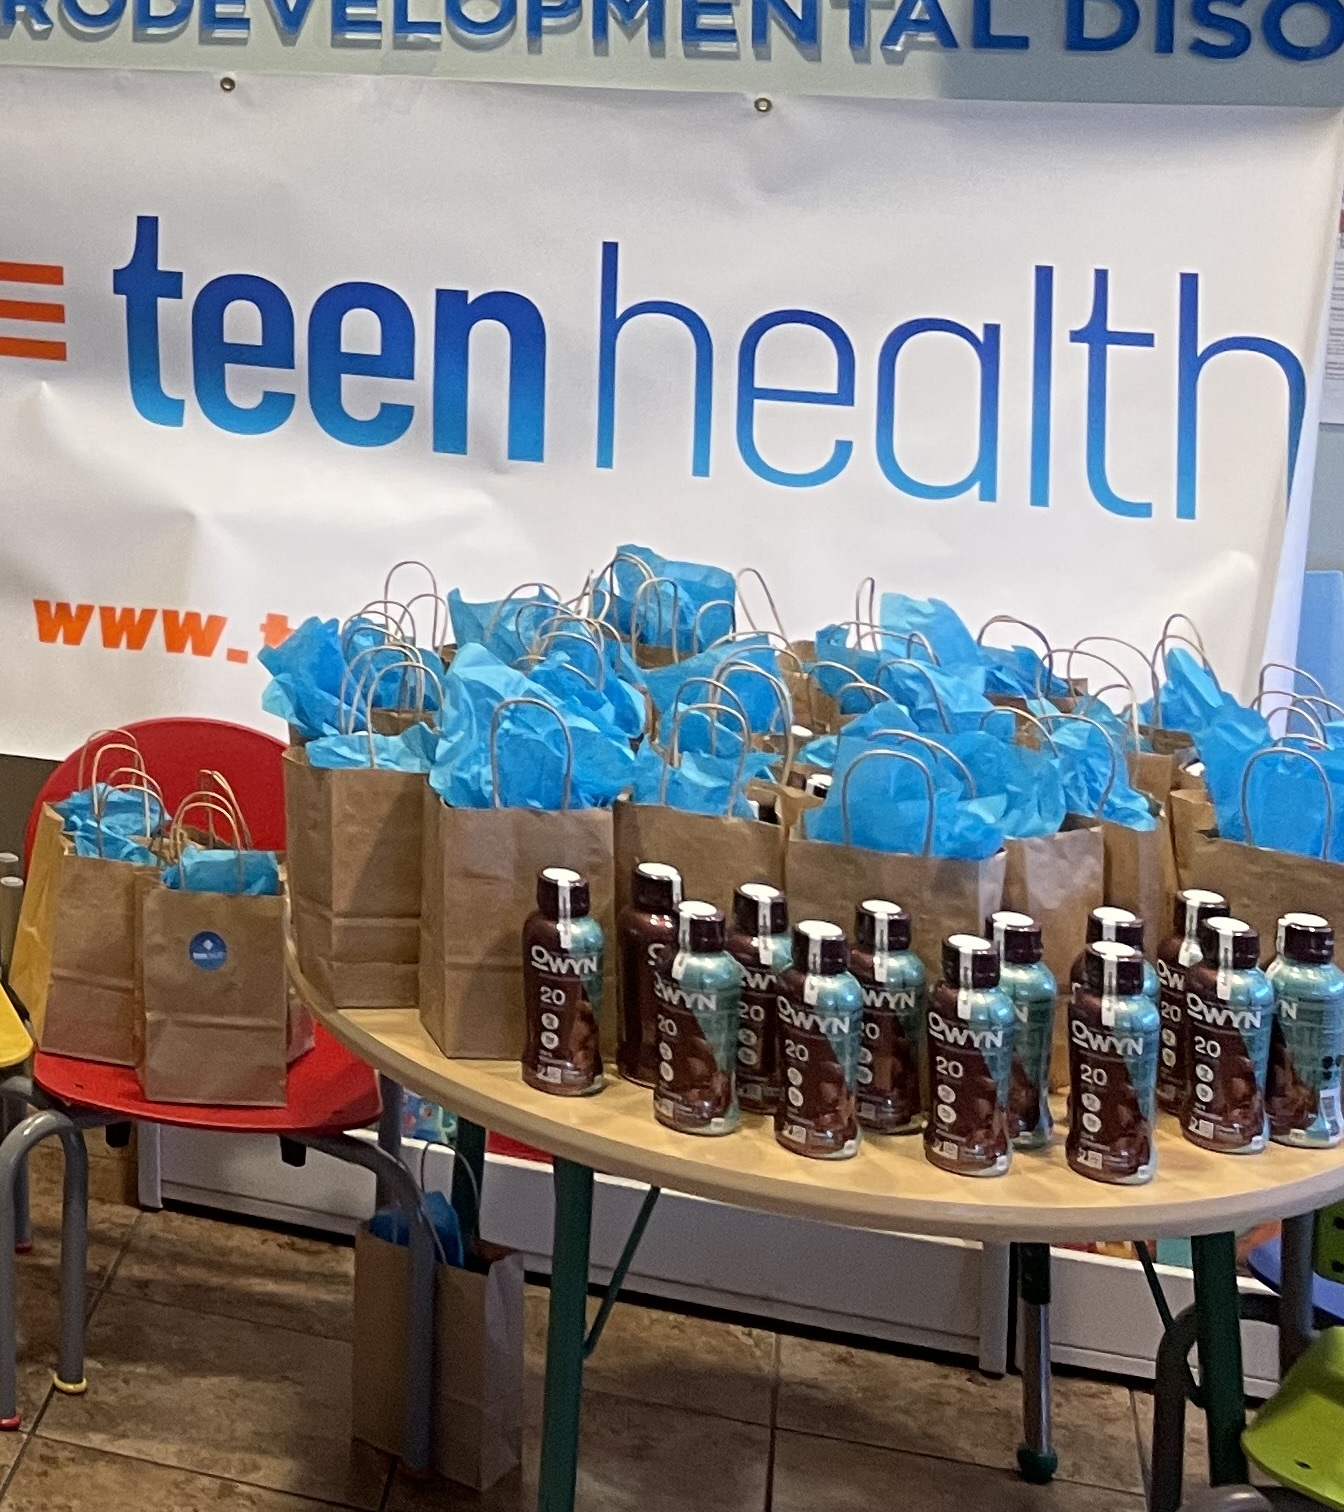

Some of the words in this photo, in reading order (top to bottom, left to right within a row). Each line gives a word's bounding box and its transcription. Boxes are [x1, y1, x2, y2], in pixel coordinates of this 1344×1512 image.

[111, 214, 547, 463] teen
[596, 241, 1306, 521] health
[540, 986, 566, 1006] 20
[862, 988, 915, 1009] WYN
[738, 1000, 765, 1022] 20
[1161, 1000, 1182, 1023] 20
[862, 1021, 880, 1040] 0
[784, 1039, 809, 1062] 20
[1194, 1035, 1222, 1058] 20
[935, 1055, 963, 1079] 20
[1080, 1063, 1108, 1086] 20
